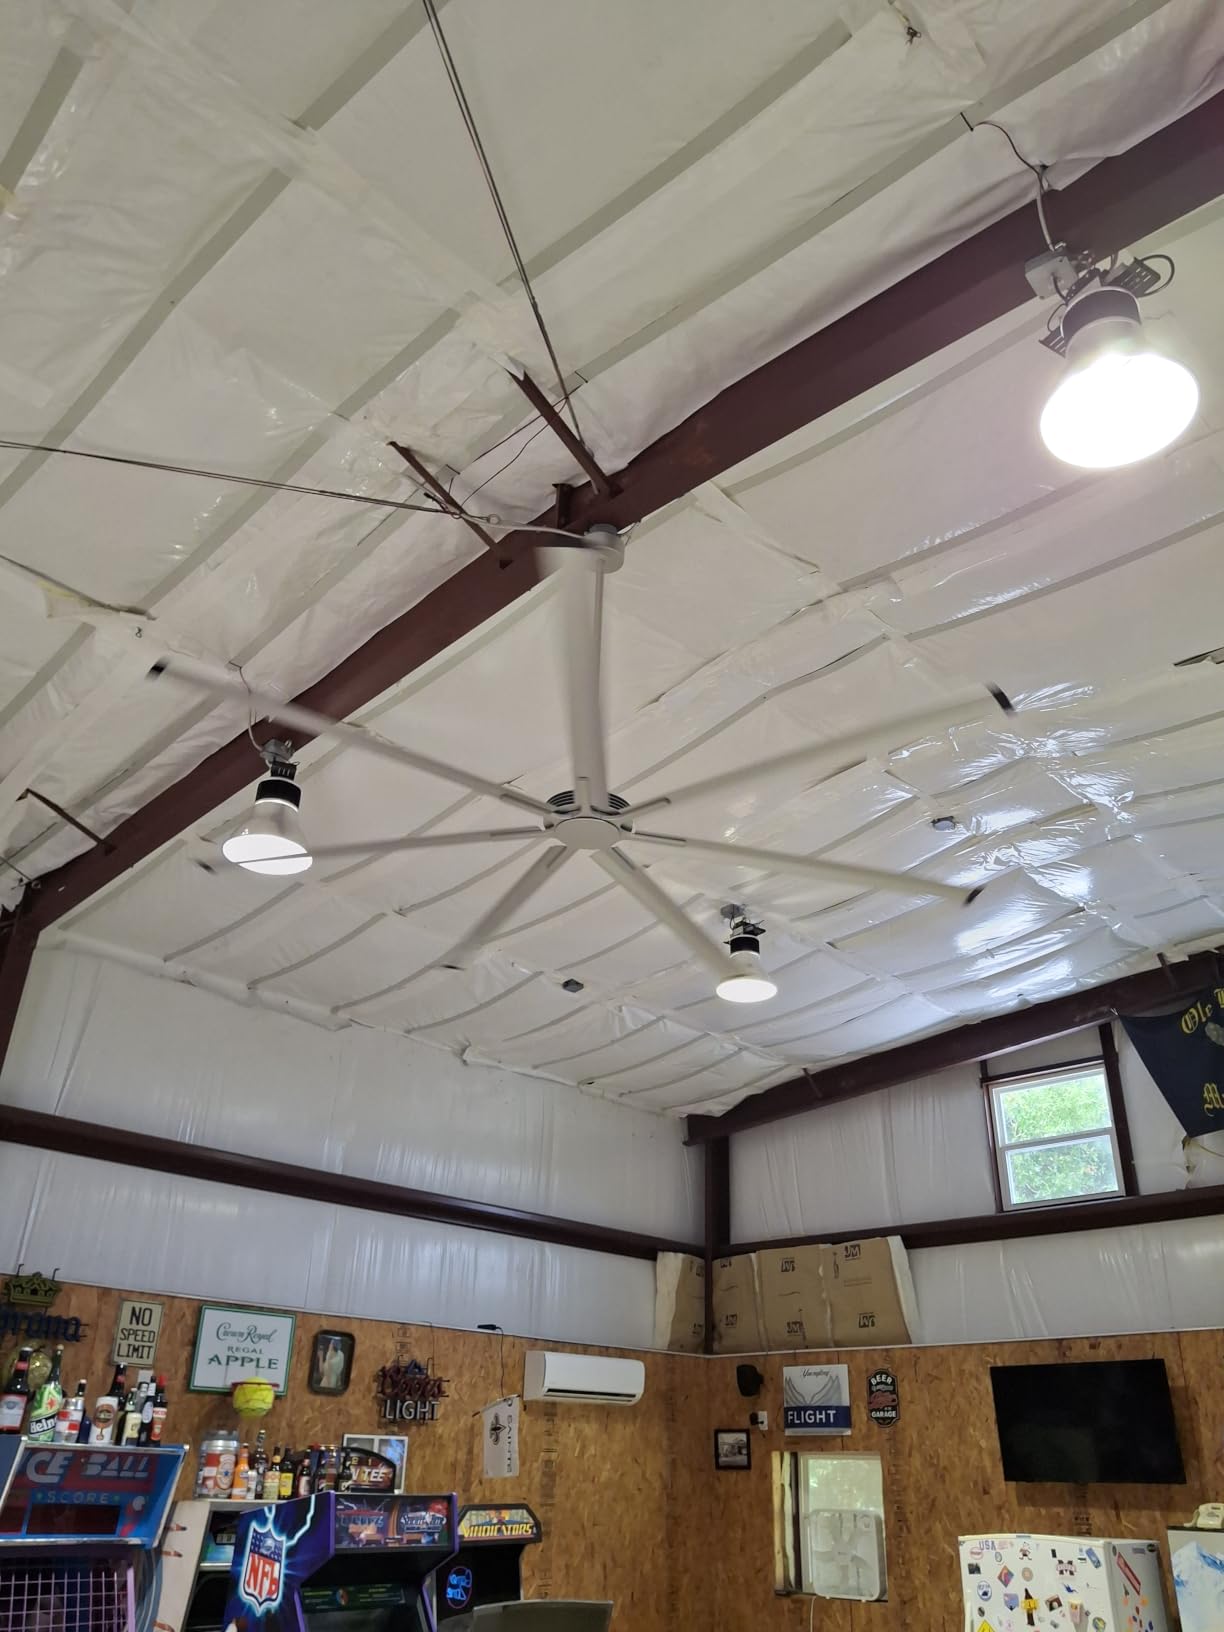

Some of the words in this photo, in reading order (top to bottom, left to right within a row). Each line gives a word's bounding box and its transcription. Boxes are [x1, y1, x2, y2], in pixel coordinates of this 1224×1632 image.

[129, 1306, 152, 1326] NO
[119, 1327, 155, 1343] SPEED
[117, 1343, 153, 1360] LIMIT
[227, 1345, 264, 1355] REGAL
[207, 1354, 279, 1370] APPLE
[870, 1374, 893, 1386] BEER
[385, 1399, 440, 1420] LIGHT
[787, 1410, 837, 1424] FLIGHT
[871, 1410, 897, 1418] GARAGE
[81, 1453, 149, 1478] BALL
[47, 1491, 111, 1504] SCORE
[978, 1539, 997, 1552] USA
[246, 1552, 280, 1600] NFL
